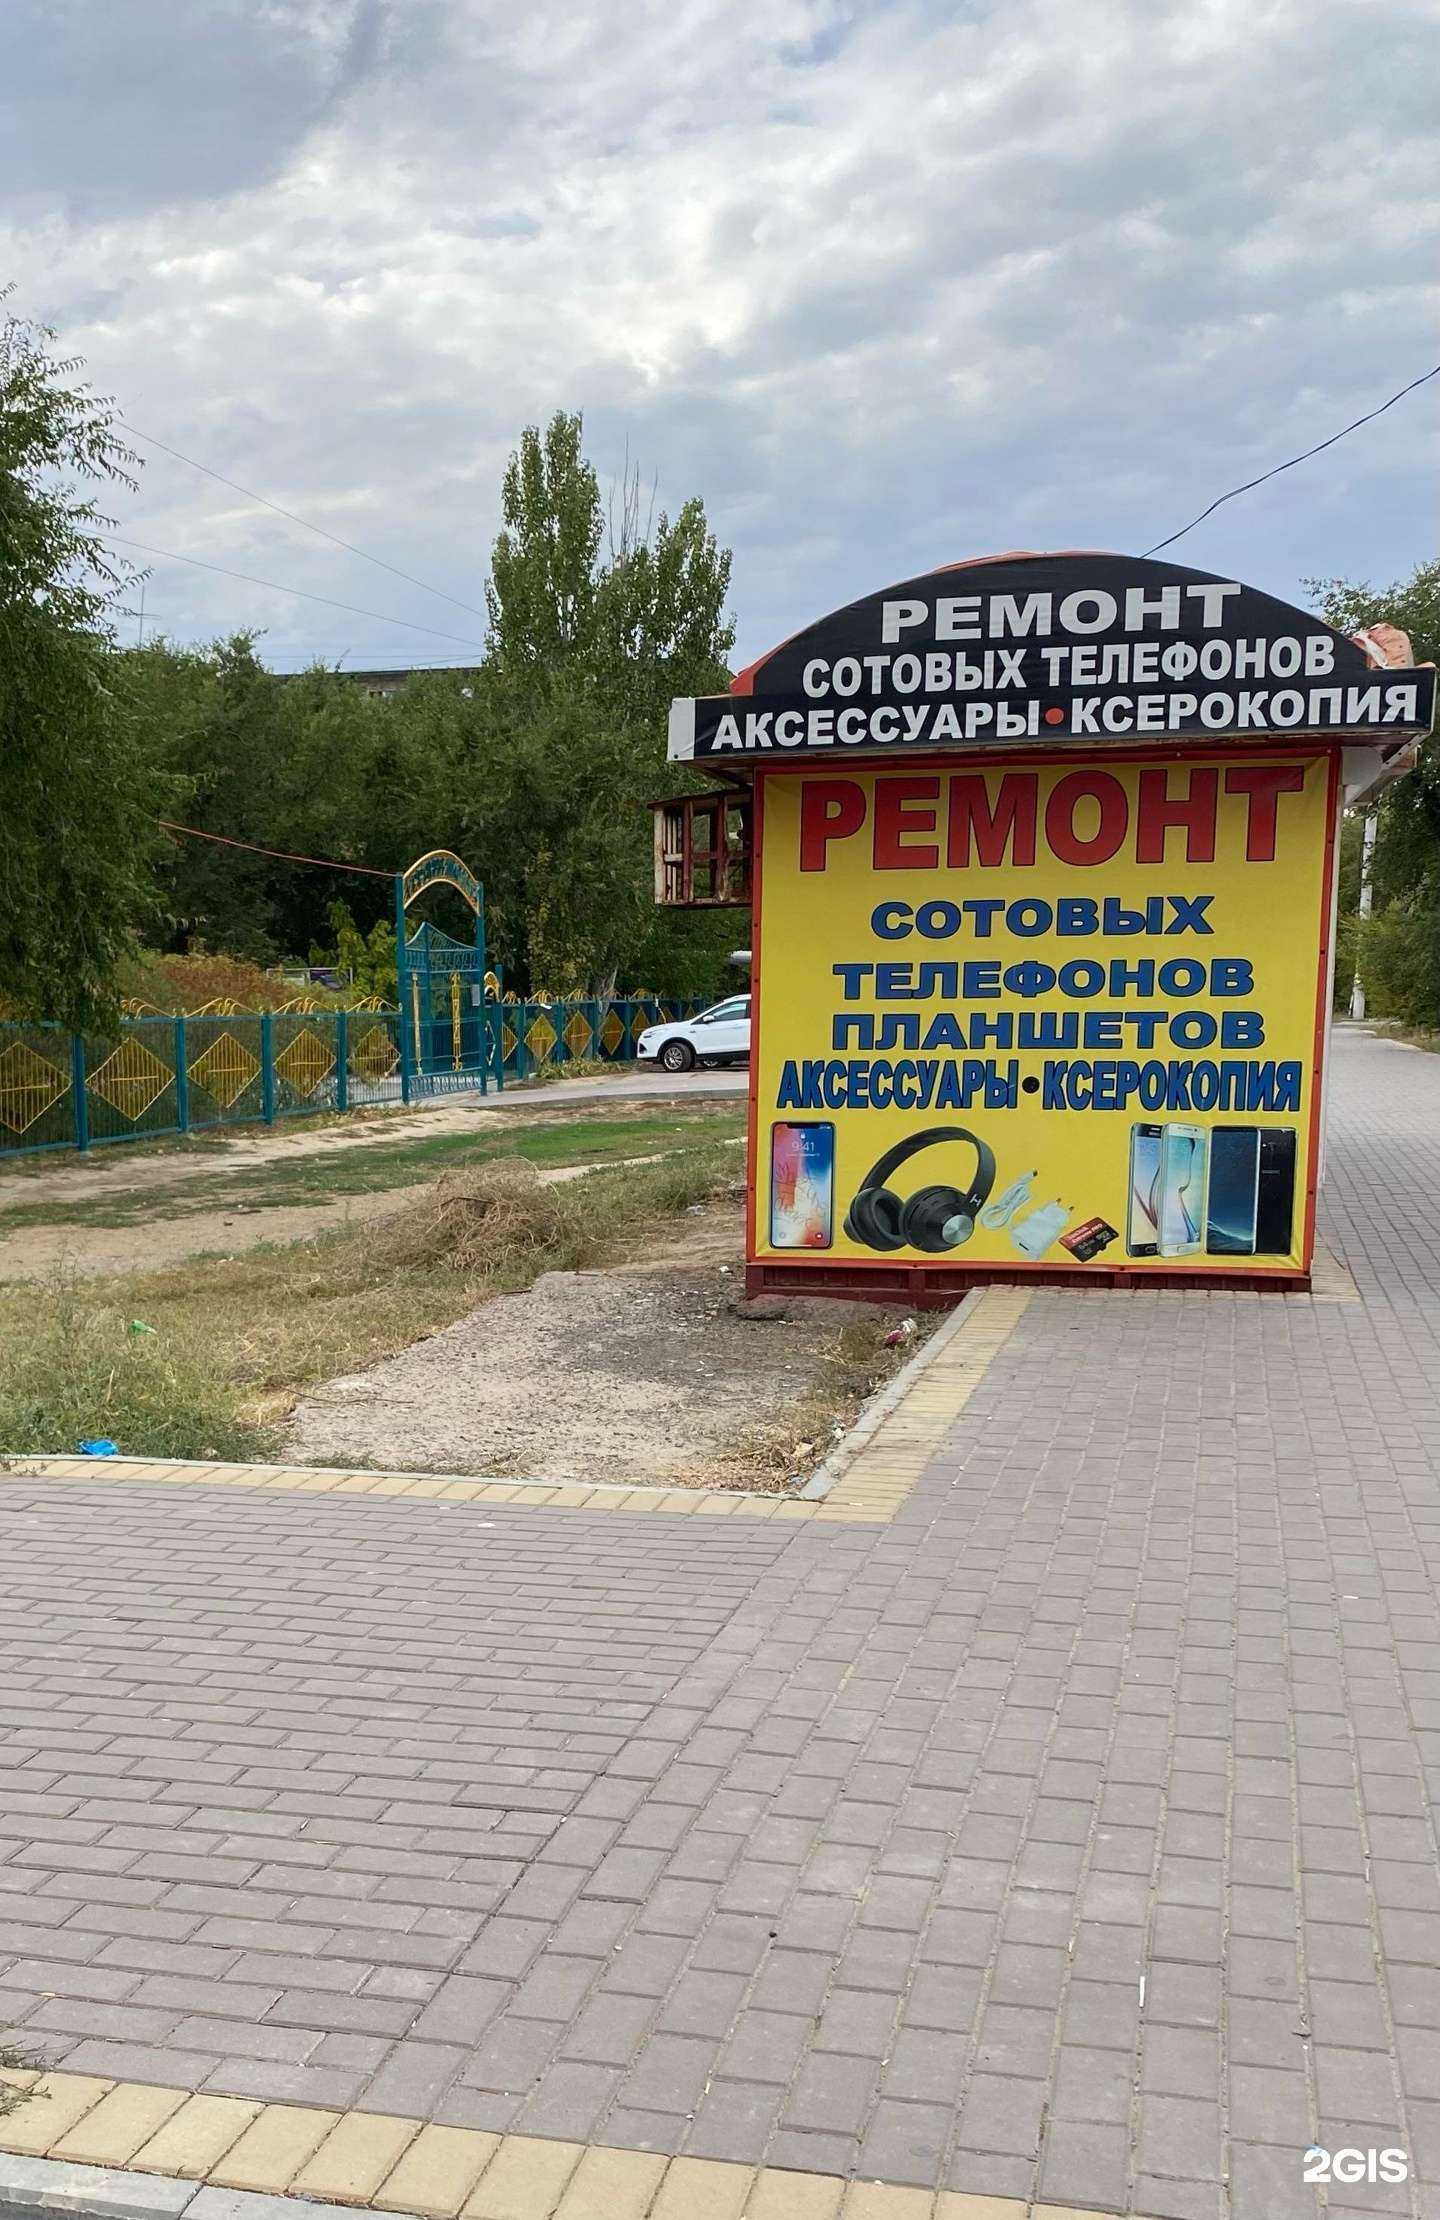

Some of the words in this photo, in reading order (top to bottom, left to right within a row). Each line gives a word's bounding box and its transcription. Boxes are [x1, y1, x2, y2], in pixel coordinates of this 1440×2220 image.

[881, 584, 1240, 643] РЕМОНТ
[802, 650, 1026, 698] СОТОВЫХ
[1040, 635, 1336, 687] ТЕЛЕФОНОВ
[711, 699, 1039, 751] АКСЕССУАРЫ
[1071, 684, 1418, 735] КСЕРОКОПИЯ
[800, 766, 1305, 872] РЕМОНТ
[871, 896, 1215, 939] СОТОВЫХ
[832, 958, 1254, 1000] ТЕЛЕФОНОВ
[832, 1011, 1265, 1050] ПЛАНШЕТОВ
[777, 1060, 1019, 1110] АКСЕССУАРЫ
[1043, 1061, 1302, 1112] КСЕРОКОПИЯ
